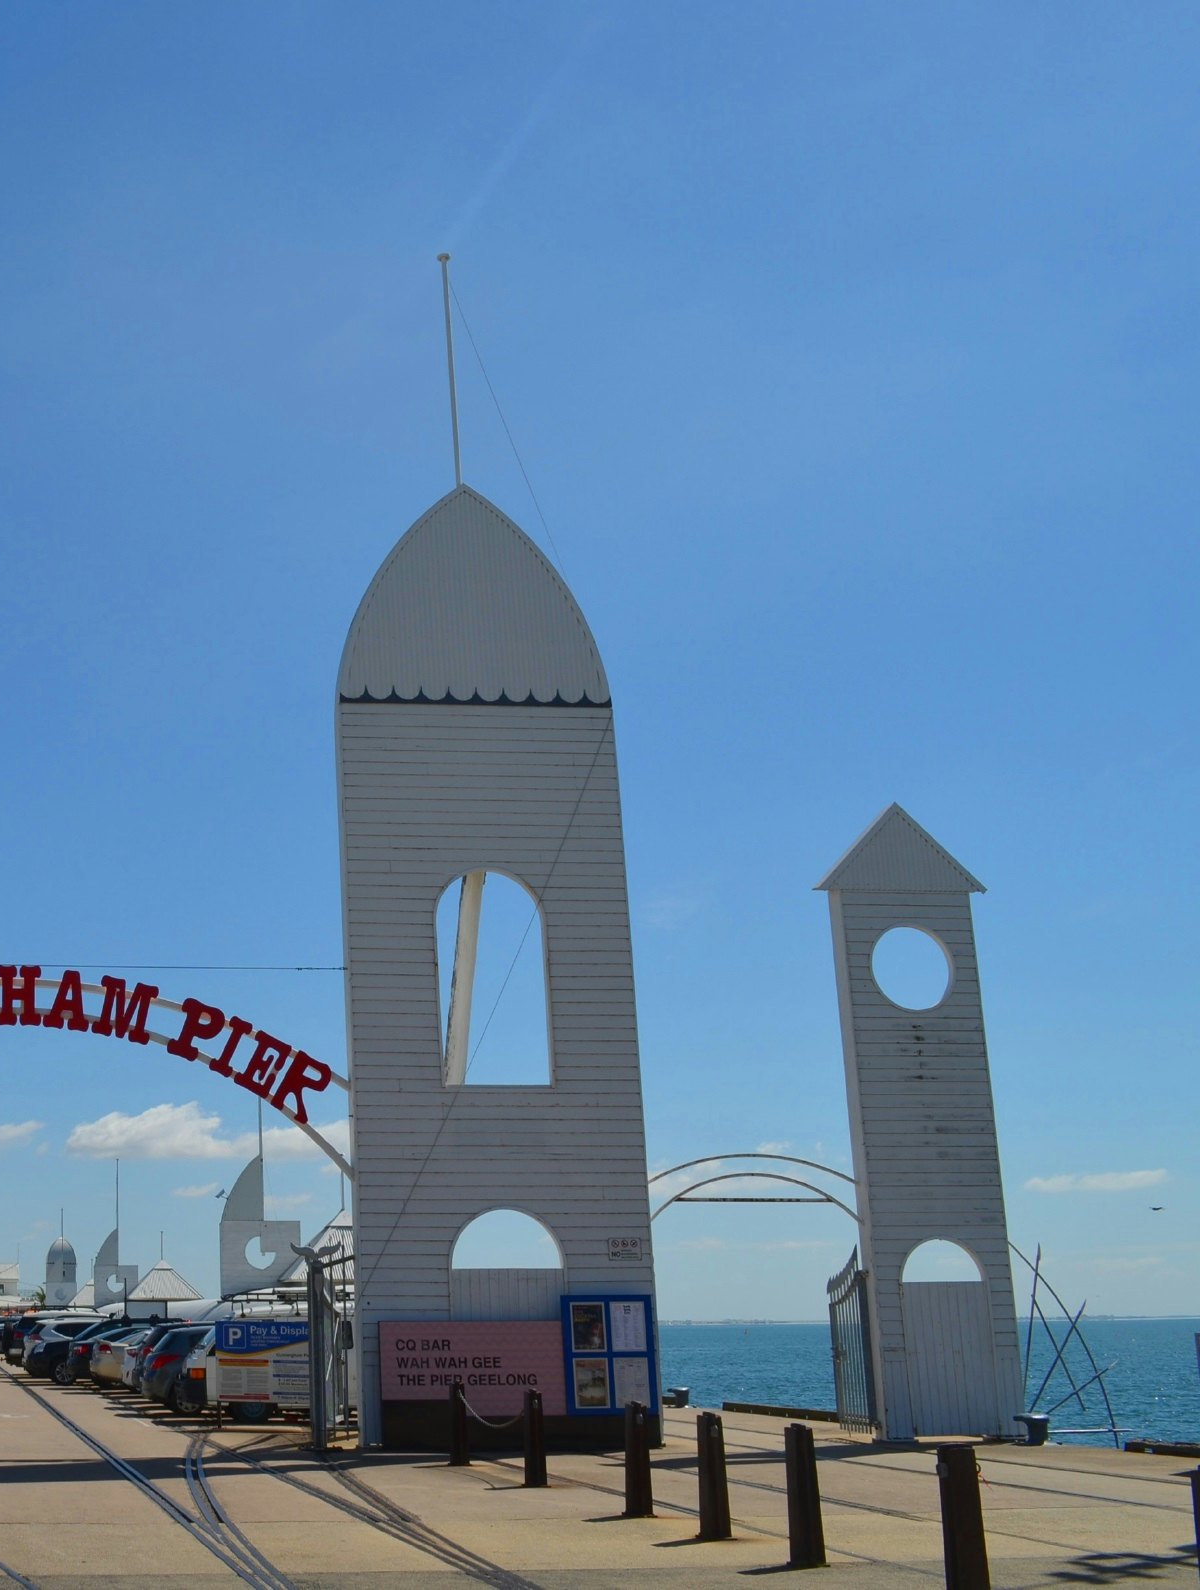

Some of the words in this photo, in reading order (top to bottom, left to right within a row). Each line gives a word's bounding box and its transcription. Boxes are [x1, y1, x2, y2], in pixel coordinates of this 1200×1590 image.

[167, 997, 332, 1124] PIER
[228, 1327, 242, 1345] P
[250, 1325, 267, 1336] Pay
[270, 1325, 278, 1335] &
[280, 1326, 309, 1336] Displa
[395, 1338, 417, 1351] CQ
[421, 1339, 451, 1351] BAR
[396, 1357, 430, 1369] WAH
[434, 1357, 468, 1369] WAH
[472, 1356, 502, 1369] GEE
[397, 1374, 426, 1386] THE
[467, 1373, 538, 1386] GEELONG
